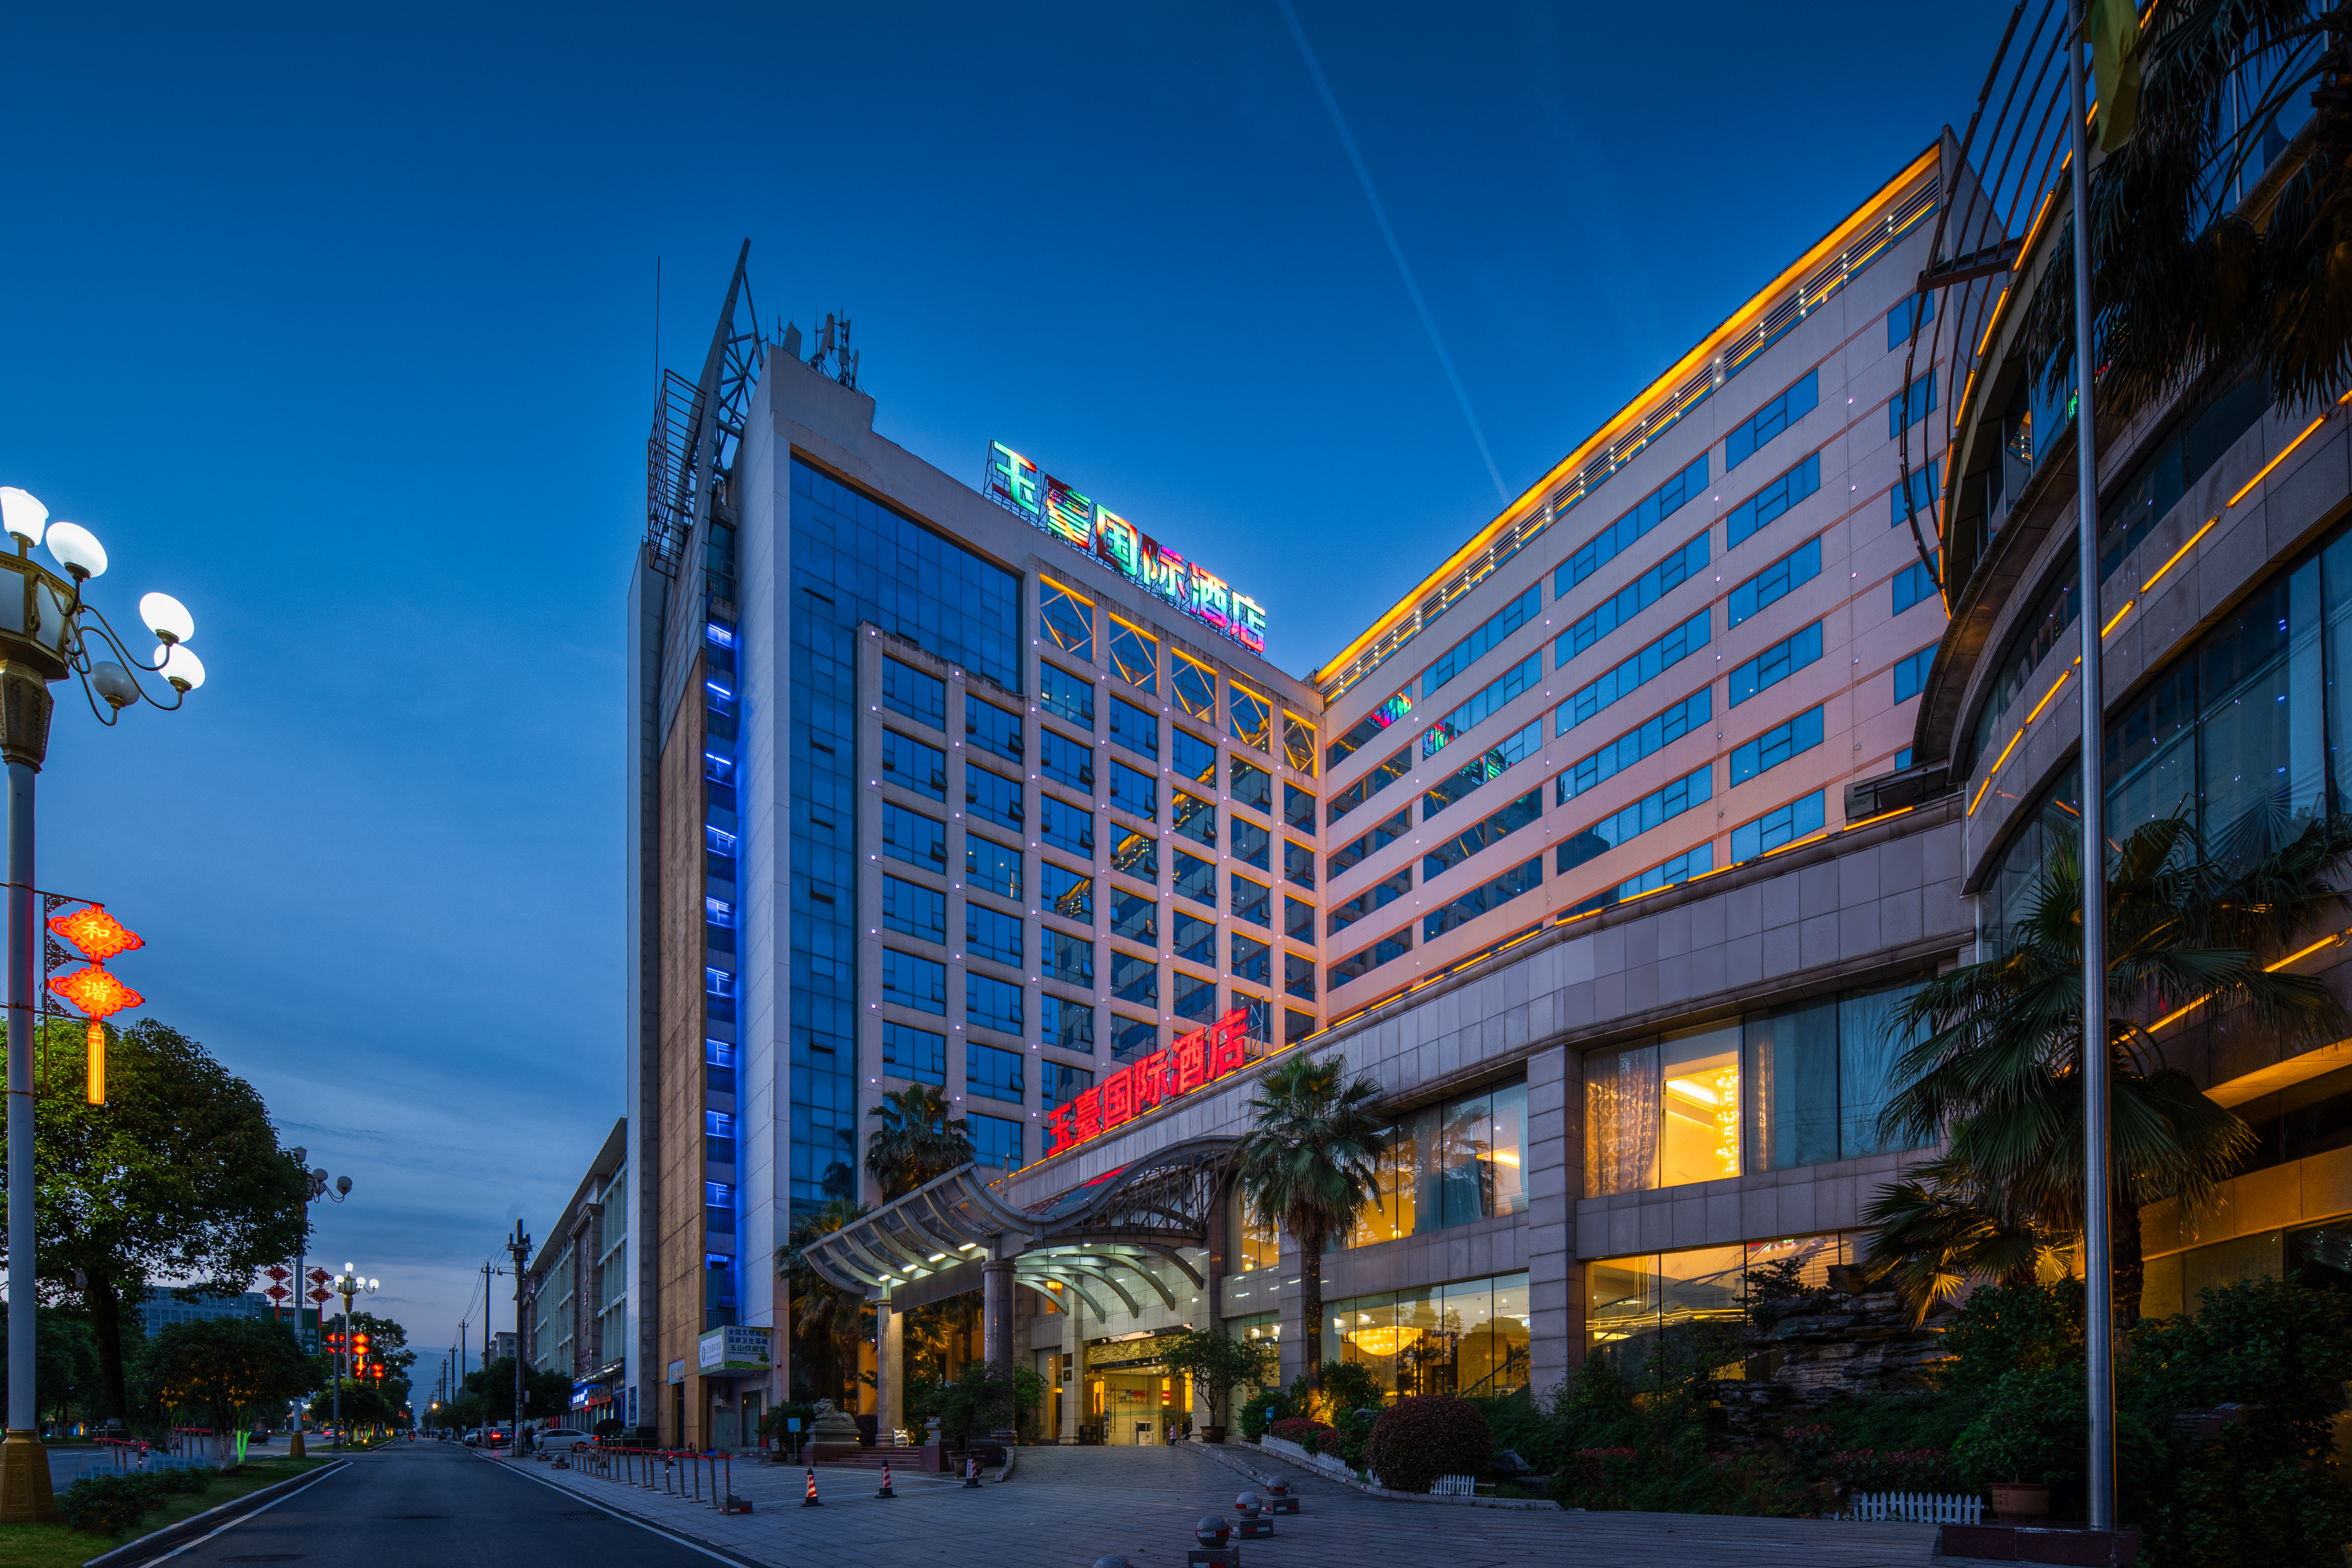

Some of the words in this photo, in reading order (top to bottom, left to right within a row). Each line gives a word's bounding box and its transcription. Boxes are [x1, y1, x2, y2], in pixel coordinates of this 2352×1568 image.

[82, 921, 111, 940] 和
[81, 980, 111, 1003] 谐
[728, 1328, 768, 1337] 全国文明城市
[728, 1336, 768, 1345] 国家卫生县城
